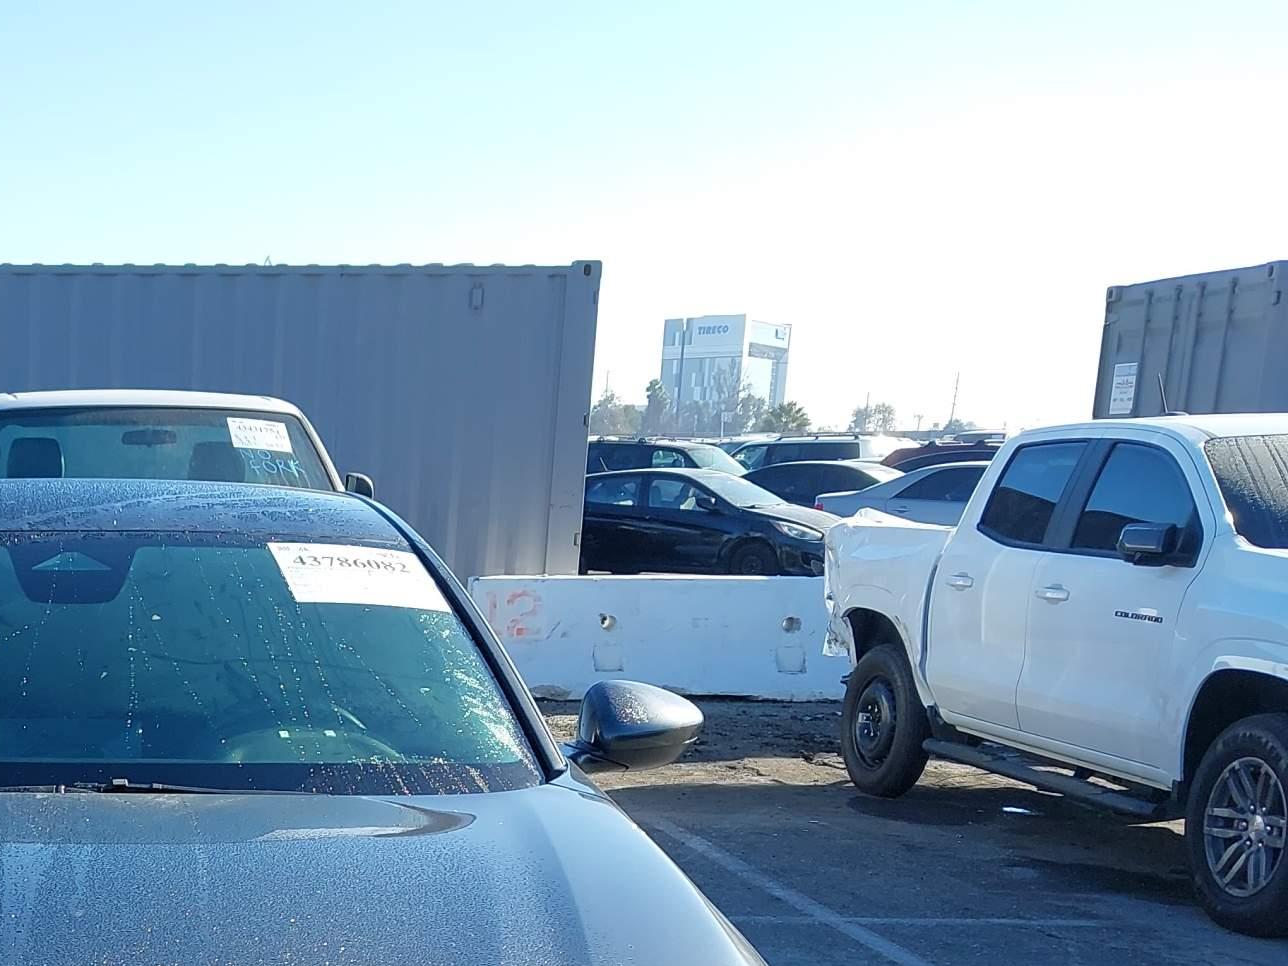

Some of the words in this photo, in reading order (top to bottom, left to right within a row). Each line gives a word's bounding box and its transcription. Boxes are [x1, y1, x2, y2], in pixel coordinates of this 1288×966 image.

[697, 325, 729, 335] TIRECO
[292, 554, 411, 574] 43786082
[486, 590, 542, 637] 12
[1114, 610, 1164, 624] COLORADO
